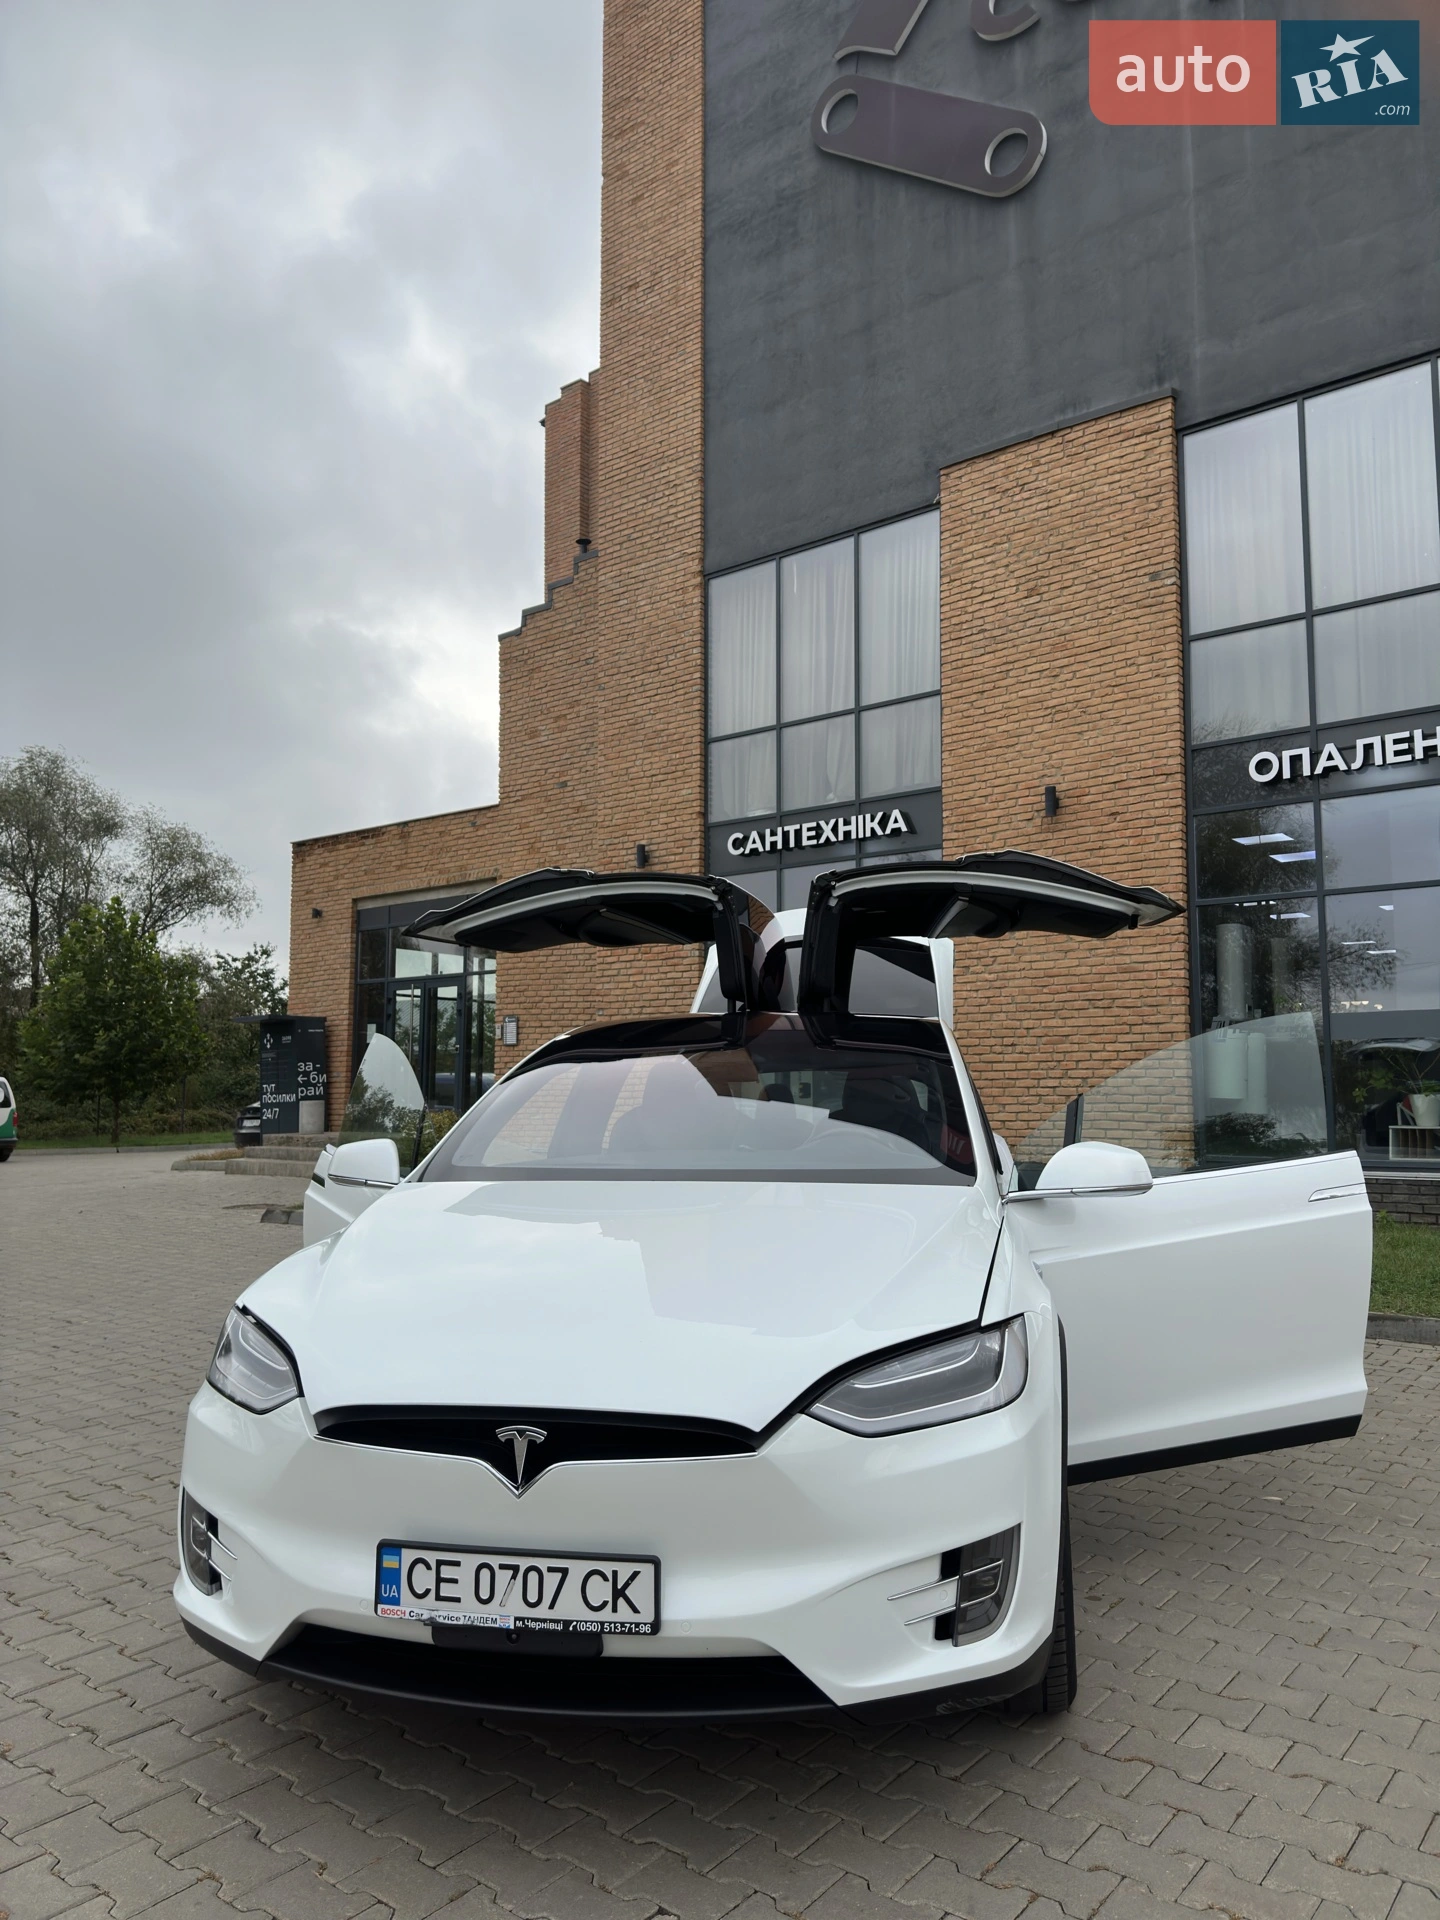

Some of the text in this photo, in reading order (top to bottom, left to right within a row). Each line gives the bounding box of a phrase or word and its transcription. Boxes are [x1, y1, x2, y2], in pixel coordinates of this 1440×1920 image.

[727, 808, 908, 857] САНТЕХНІКА
[309, 1071, 327, 1083] би
[262, 1083, 276, 1095] тут
[298, 1083, 324, 1099] рай
[262, 1093, 296, 1103] посилки
[262, 1108, 280, 1120] 24/7
[381, 1584, 399, 1598] UA
[406, 1556, 641, 1614] CE 0707 CK
[380, 1607, 406, 1617] BOSCH
[408, 1610, 424, 1619] Car
[462, 1614, 498, 1625] ТАНДЕМ
[515, 1619, 563, 1630] м.Чернівці
[576, 1621, 601, 1633] (050)
[603, 1622, 652, 1634] 513-71-96
